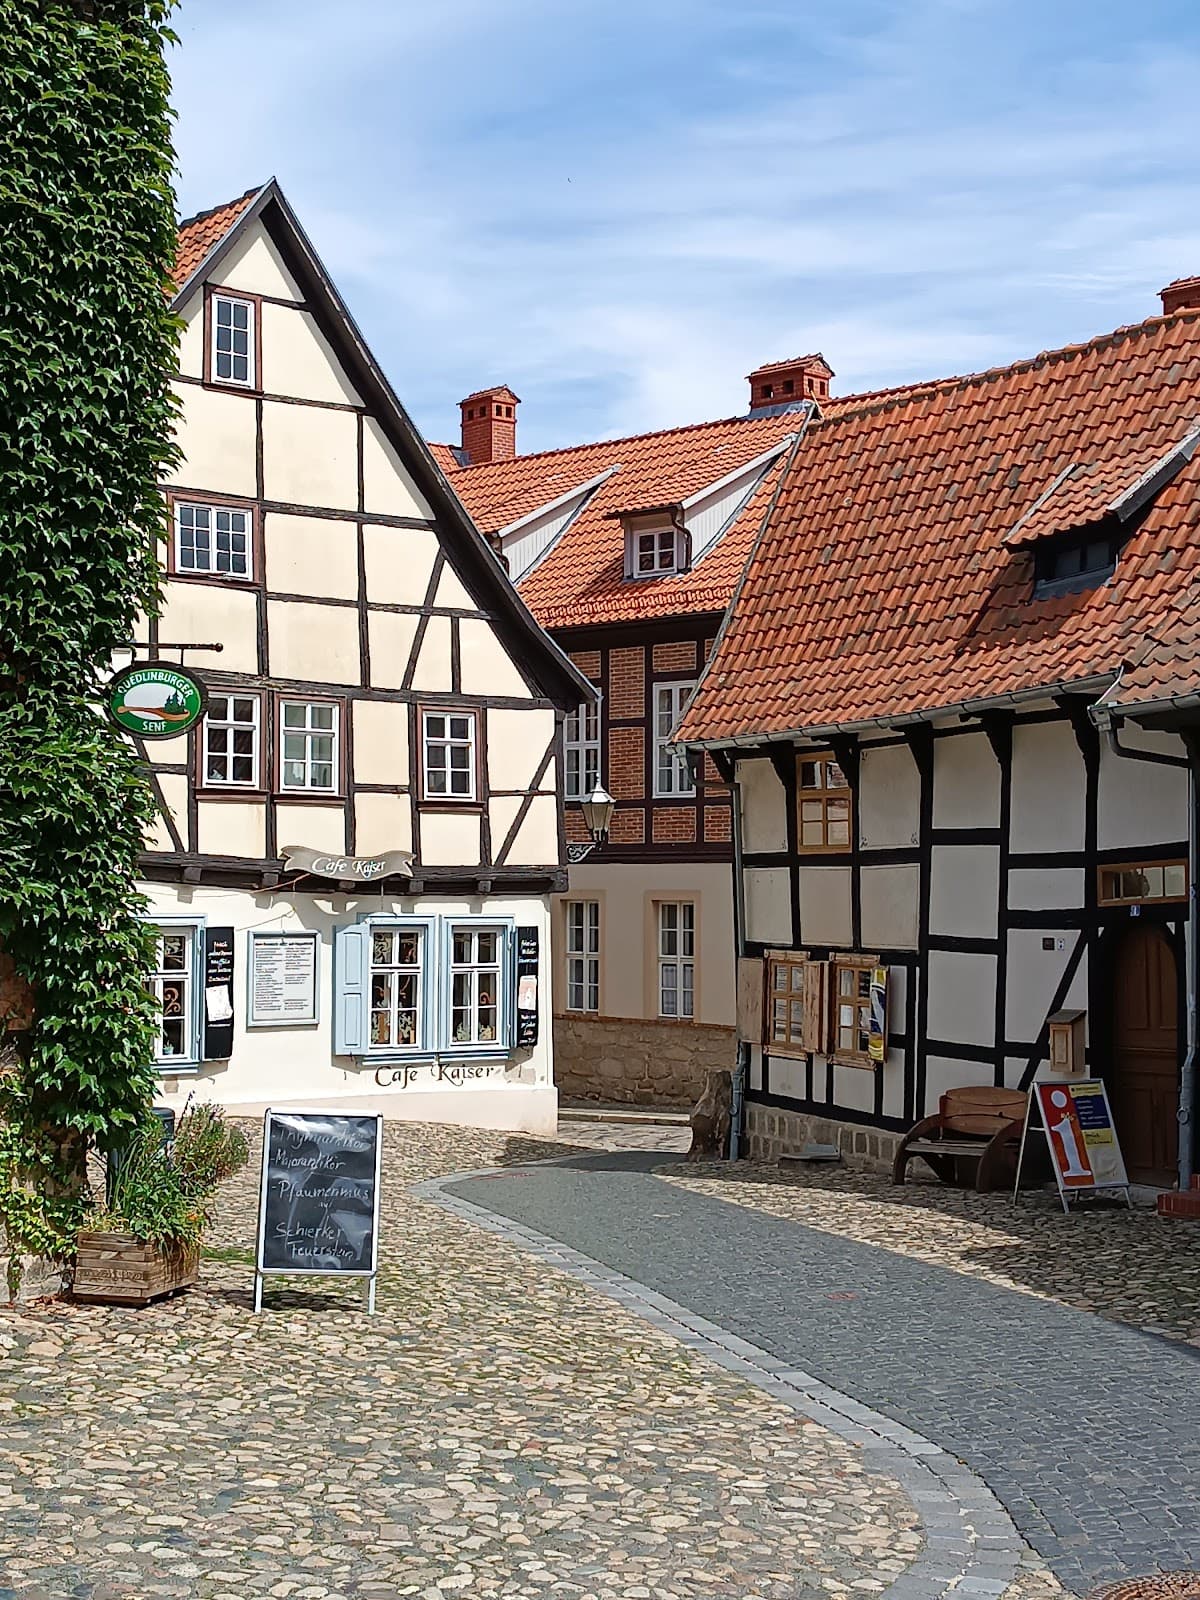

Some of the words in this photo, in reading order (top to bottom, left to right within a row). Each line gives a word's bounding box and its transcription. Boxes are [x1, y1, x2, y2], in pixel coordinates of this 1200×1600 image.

[117, 671, 194, 698] QUEDLINBURGER
[142, 722, 167, 732] SENF
[311, 857, 347, 875] Cafe
[352, 860, 385, 878] Kaiser
[375, 1064, 418, 1089] Cafe
[431, 1063, 494, 1087] Kaiser
